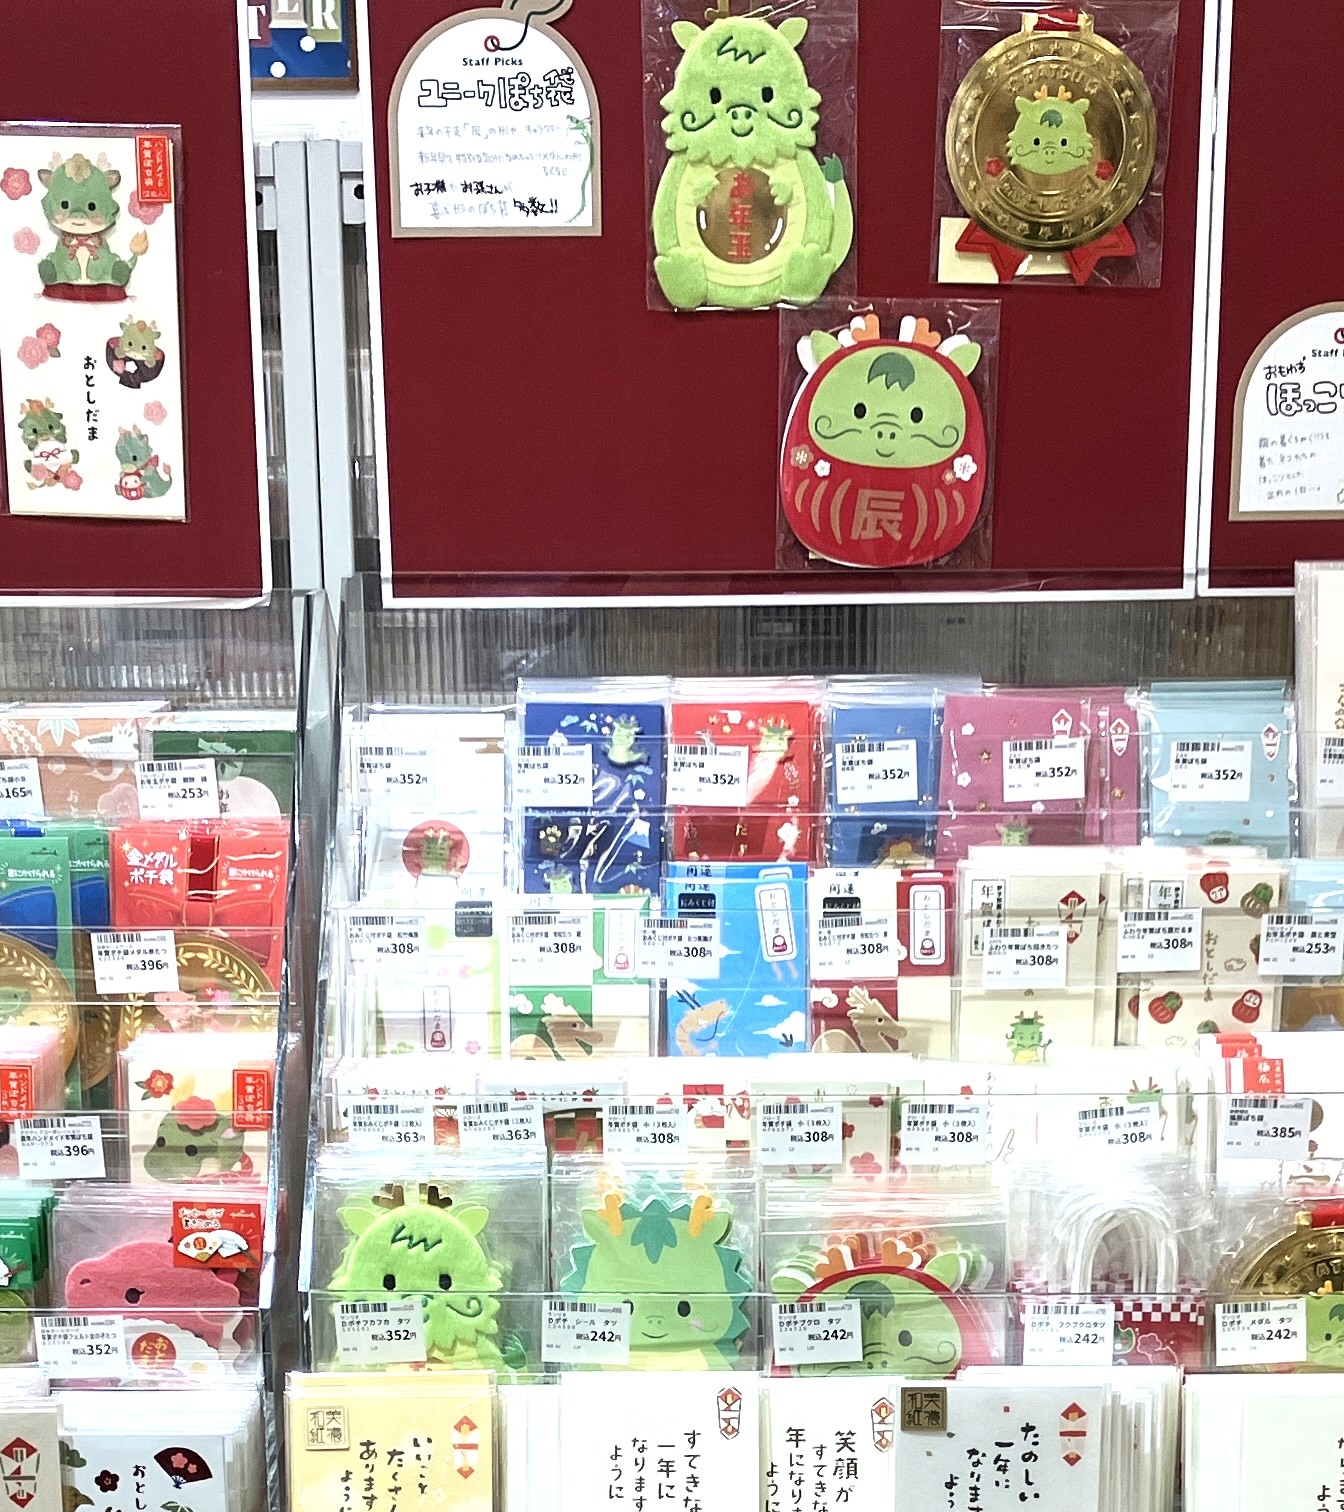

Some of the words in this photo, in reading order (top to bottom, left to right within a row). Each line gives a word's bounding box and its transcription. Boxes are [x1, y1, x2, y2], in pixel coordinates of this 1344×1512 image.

[463, 58, 489, 66] Staff
[495, 58, 522, 66] Picks
[418, 66, 575, 110] ユニークぽち袋
[729, 171, 753, 258] お年玉
[1263, 356, 1306, 380] おもわず
[1312, 349, 1338, 357] Staff
[82, 354, 99, 442] おとしだま
[850, 489, 905, 541] 辰
[1036, 766, 1077, 777] 税込352円
[168, 786, 209, 798] 税込253円
[126, 847, 179, 870] 金メダル
[847, 943, 888, 955] 税込308円
[637, 1133, 679, 1144] 税込308円
[372, 1329, 416, 1342] 税込352円
[357, 1437, 379, 1512] あります
[607, 1443, 626, 1501] ように
[654, 1444, 678, 1500] 一年に
[831, 1429, 860, 1505] 笑顔が
[1019, 1420, 1041, 1503] たのしい
